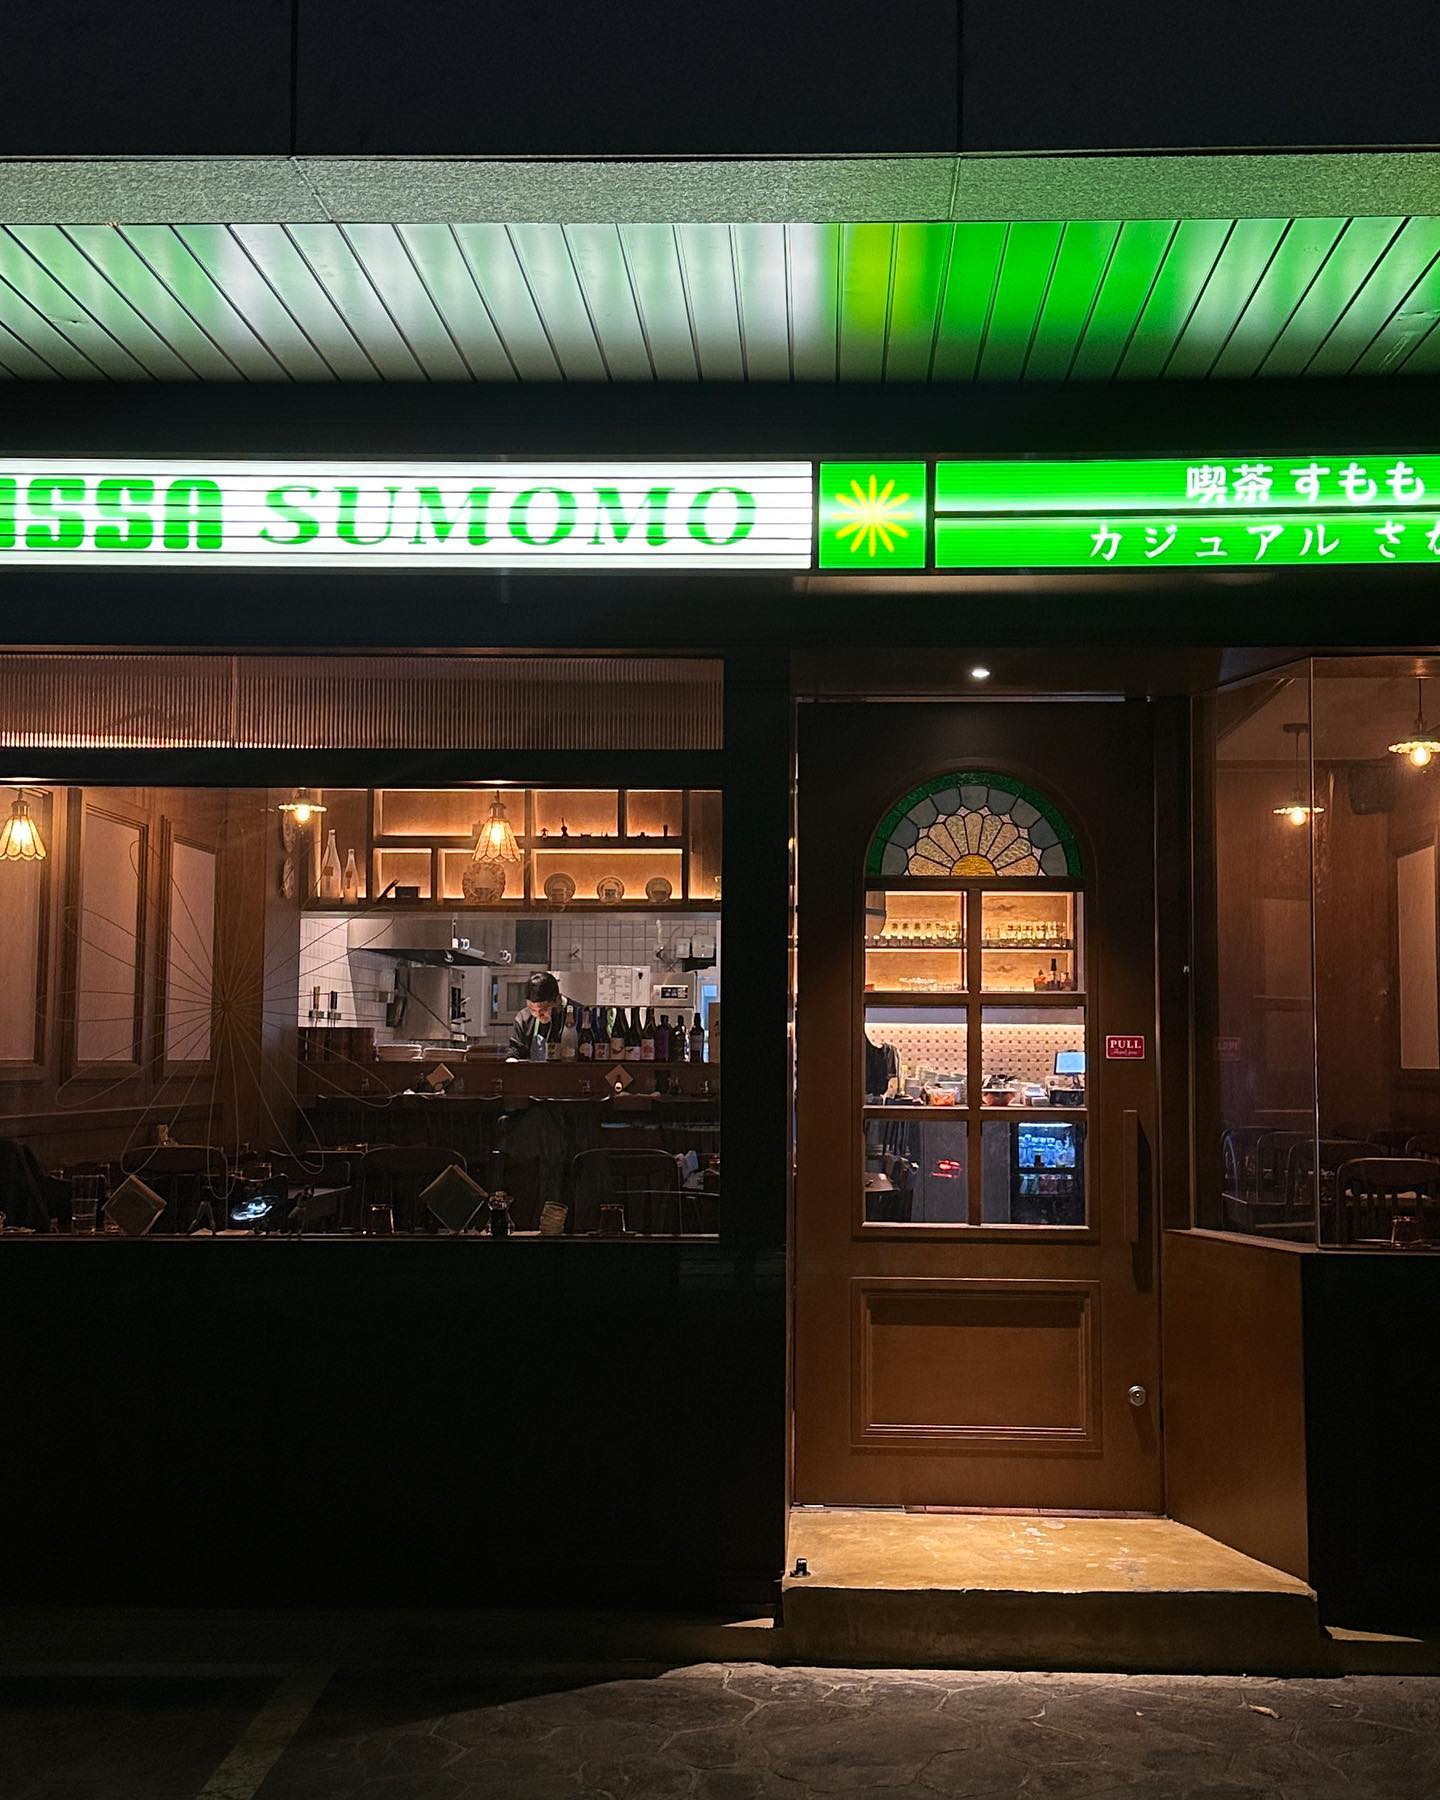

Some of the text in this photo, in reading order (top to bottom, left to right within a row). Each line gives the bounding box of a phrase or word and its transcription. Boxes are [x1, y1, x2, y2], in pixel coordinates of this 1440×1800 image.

[1186, 461, 1425, 505] 喫茶 すもも
[258, 485, 757, 547] SUMOMO
[1090, 521, 1341, 561] カジュアル
[1110, 1040, 1141, 1049] PULL
